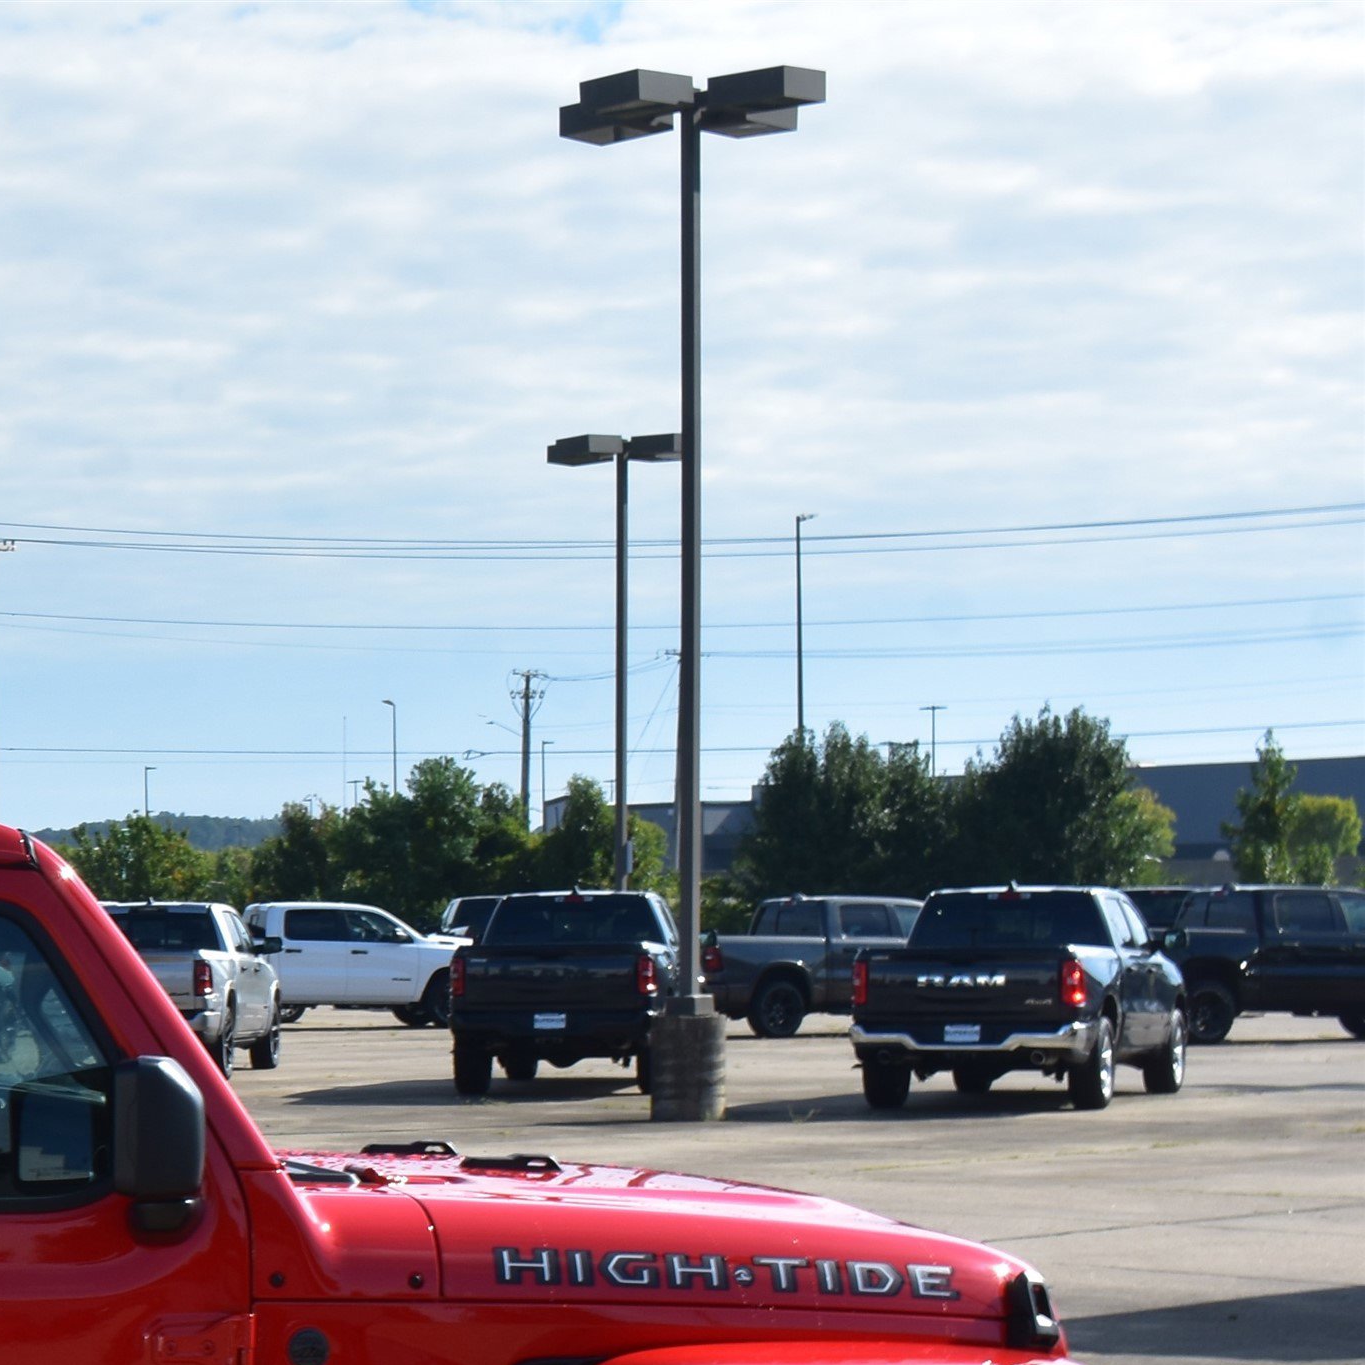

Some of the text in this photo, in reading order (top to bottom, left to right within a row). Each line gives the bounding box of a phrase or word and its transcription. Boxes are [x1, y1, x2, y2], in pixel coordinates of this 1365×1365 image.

[917, 974, 1007, 988] RAM
[492, 1247, 961, 1300] HIGH TIDE
